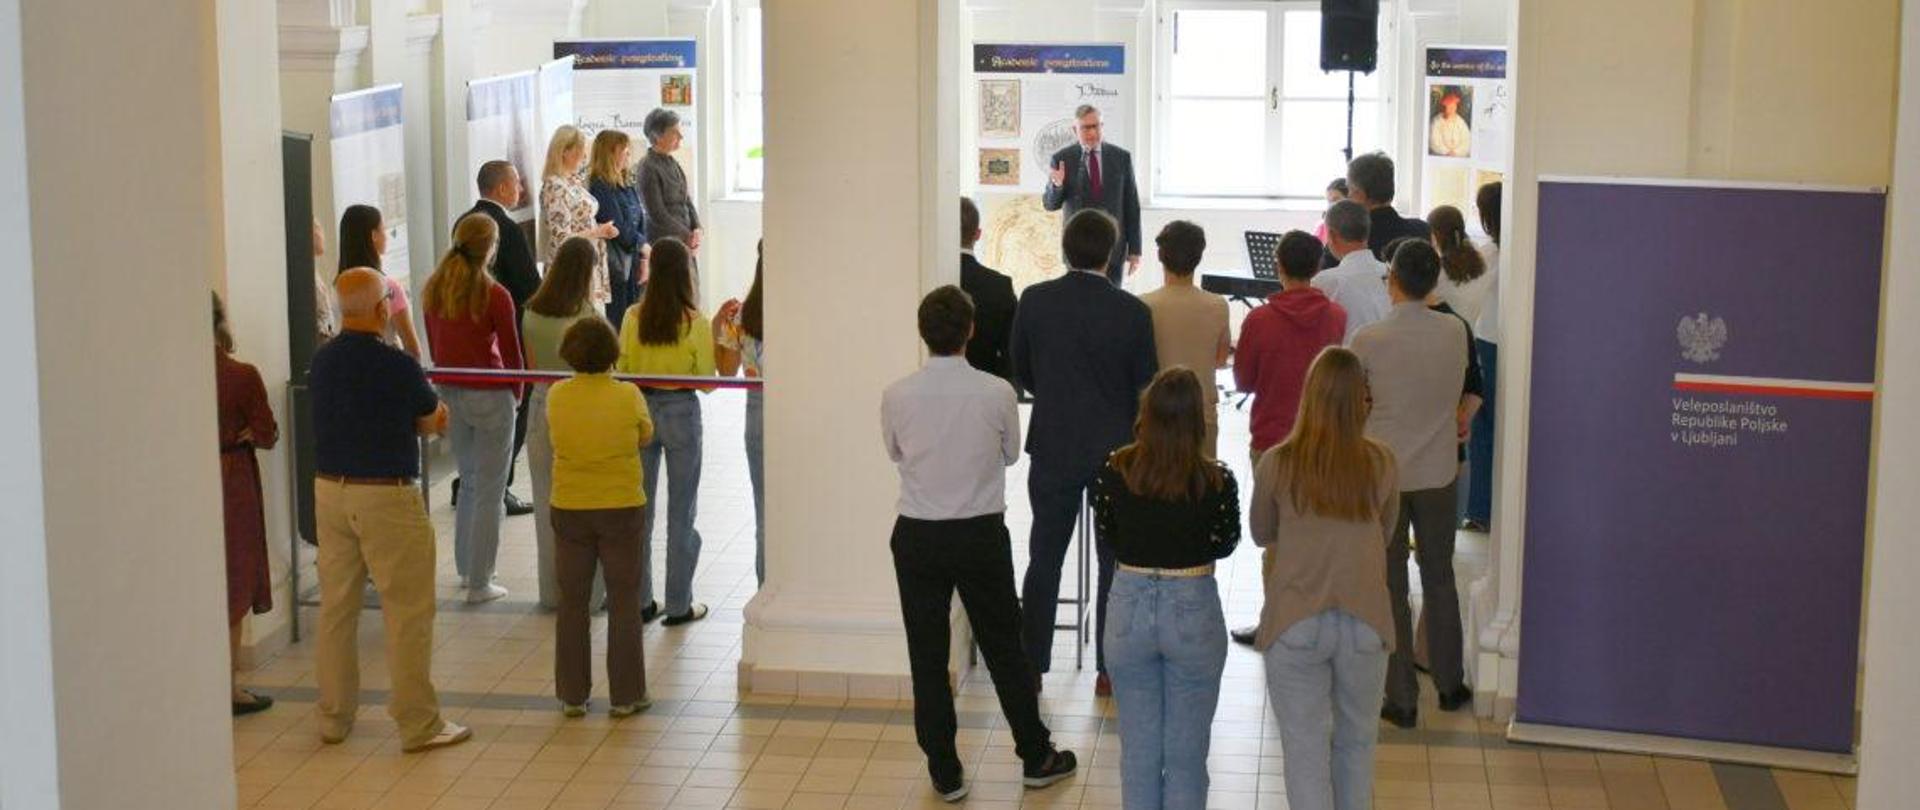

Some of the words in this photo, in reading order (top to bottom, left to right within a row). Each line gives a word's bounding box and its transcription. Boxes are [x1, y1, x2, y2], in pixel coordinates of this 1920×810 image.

[1671, 397, 1777, 416] Veleposlaništvo
[1671, 412, 1737, 430] Republike
[1740, 417, 1788, 434] Poljske
[1670, 432, 1679, 442] v
[1681, 430, 1737, 447] Ljubljani
